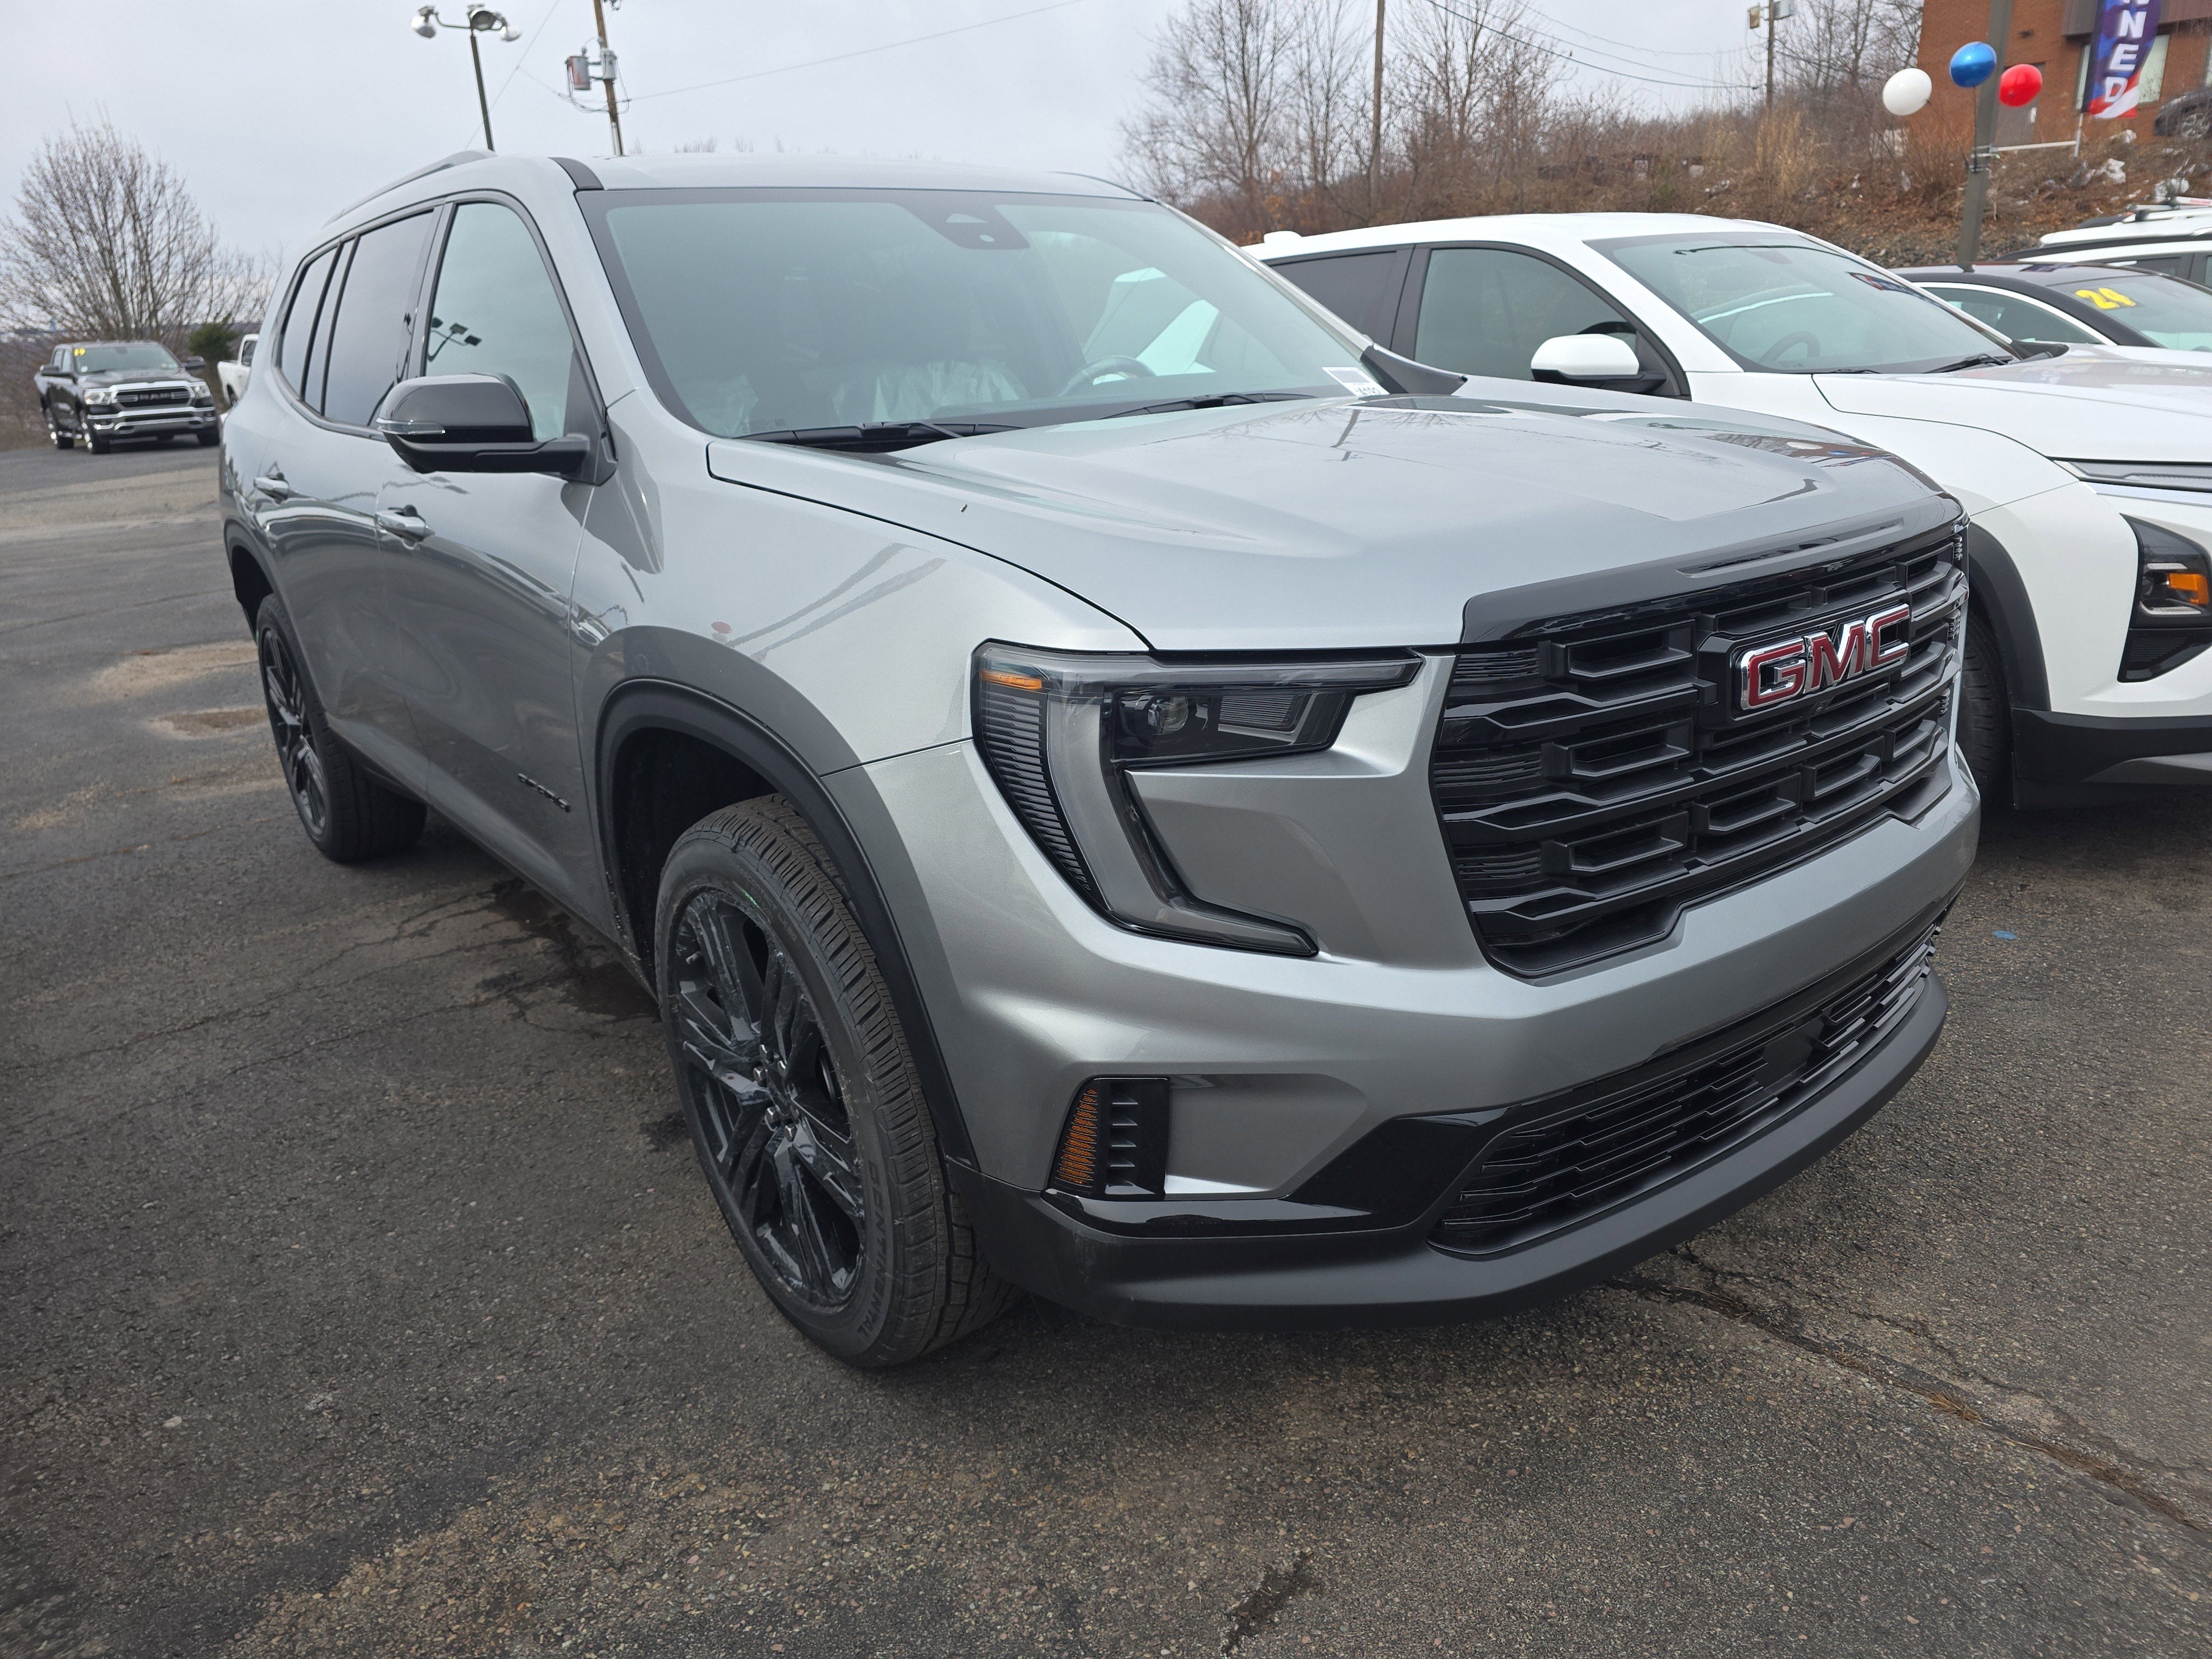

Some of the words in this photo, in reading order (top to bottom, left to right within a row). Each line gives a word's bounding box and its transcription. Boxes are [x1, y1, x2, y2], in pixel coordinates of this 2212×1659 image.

[2104, 0, 2149, 103] NED
[1740, 602, 1909, 710] GMC
[857, 1159, 886, 1336] CONTINENTAL
